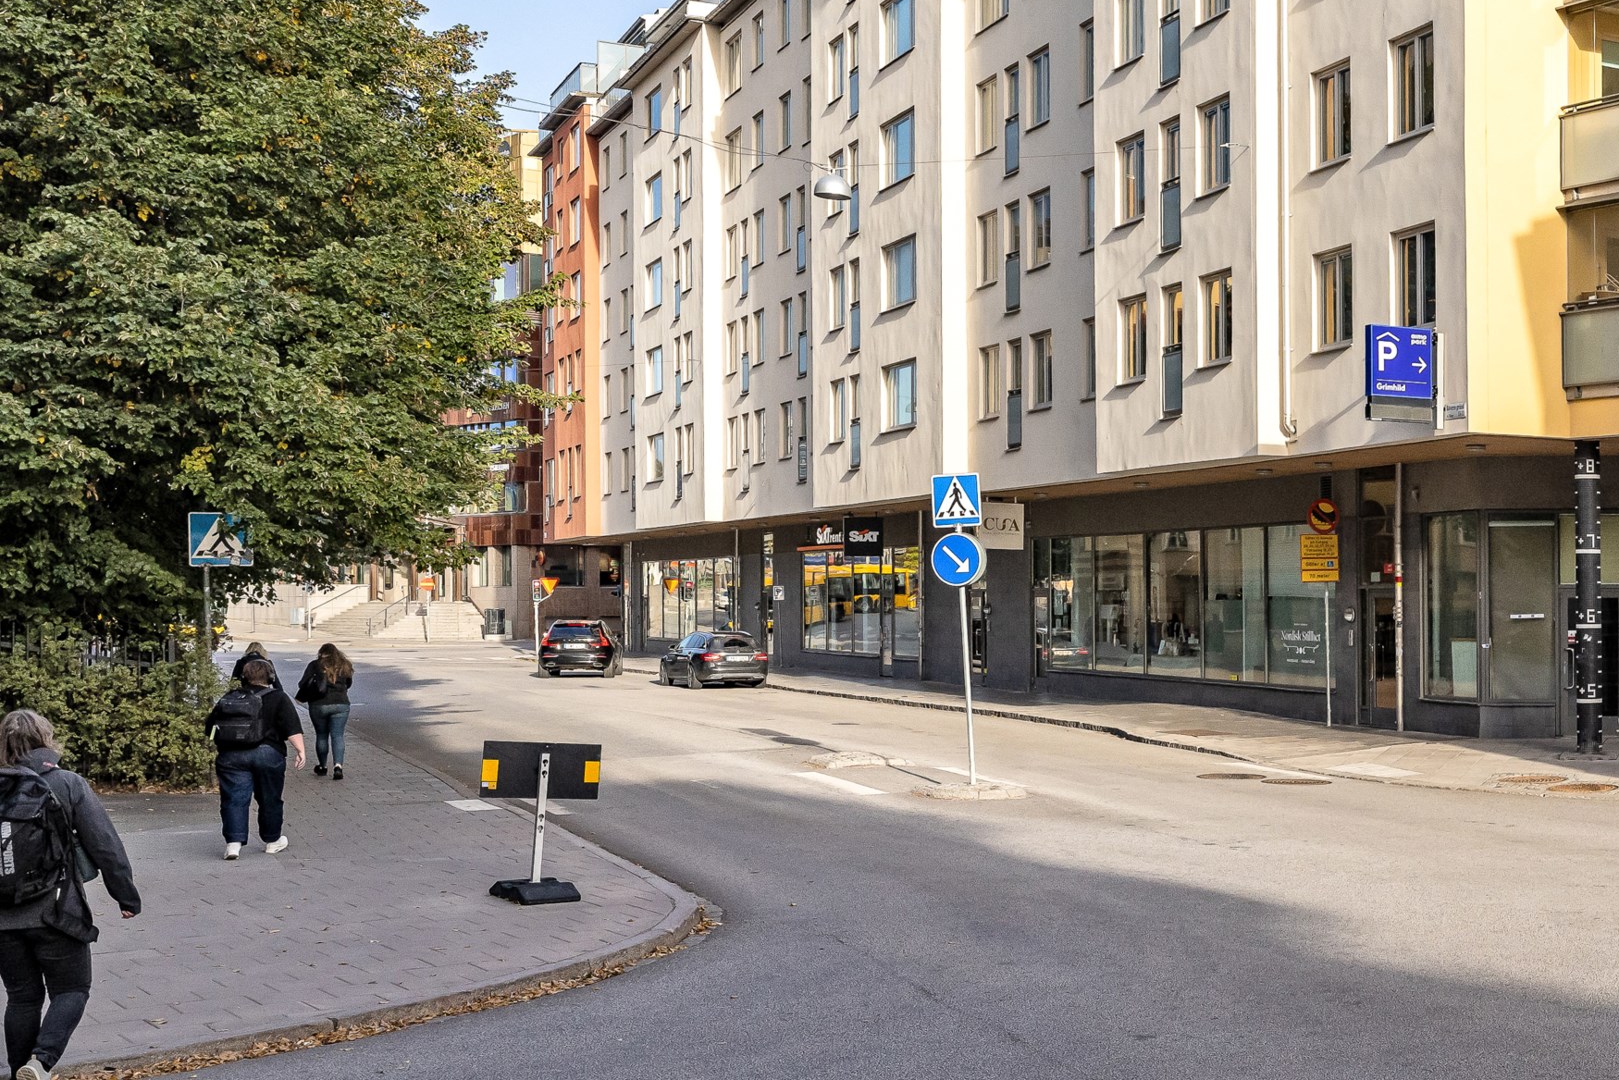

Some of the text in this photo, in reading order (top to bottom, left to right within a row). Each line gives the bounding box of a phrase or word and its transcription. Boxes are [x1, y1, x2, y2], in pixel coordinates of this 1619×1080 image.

[1377, 340, 1398, 371] P
[1376, 382, 1406, 392] Grimhild
[830, 531, 843, 543] rent
